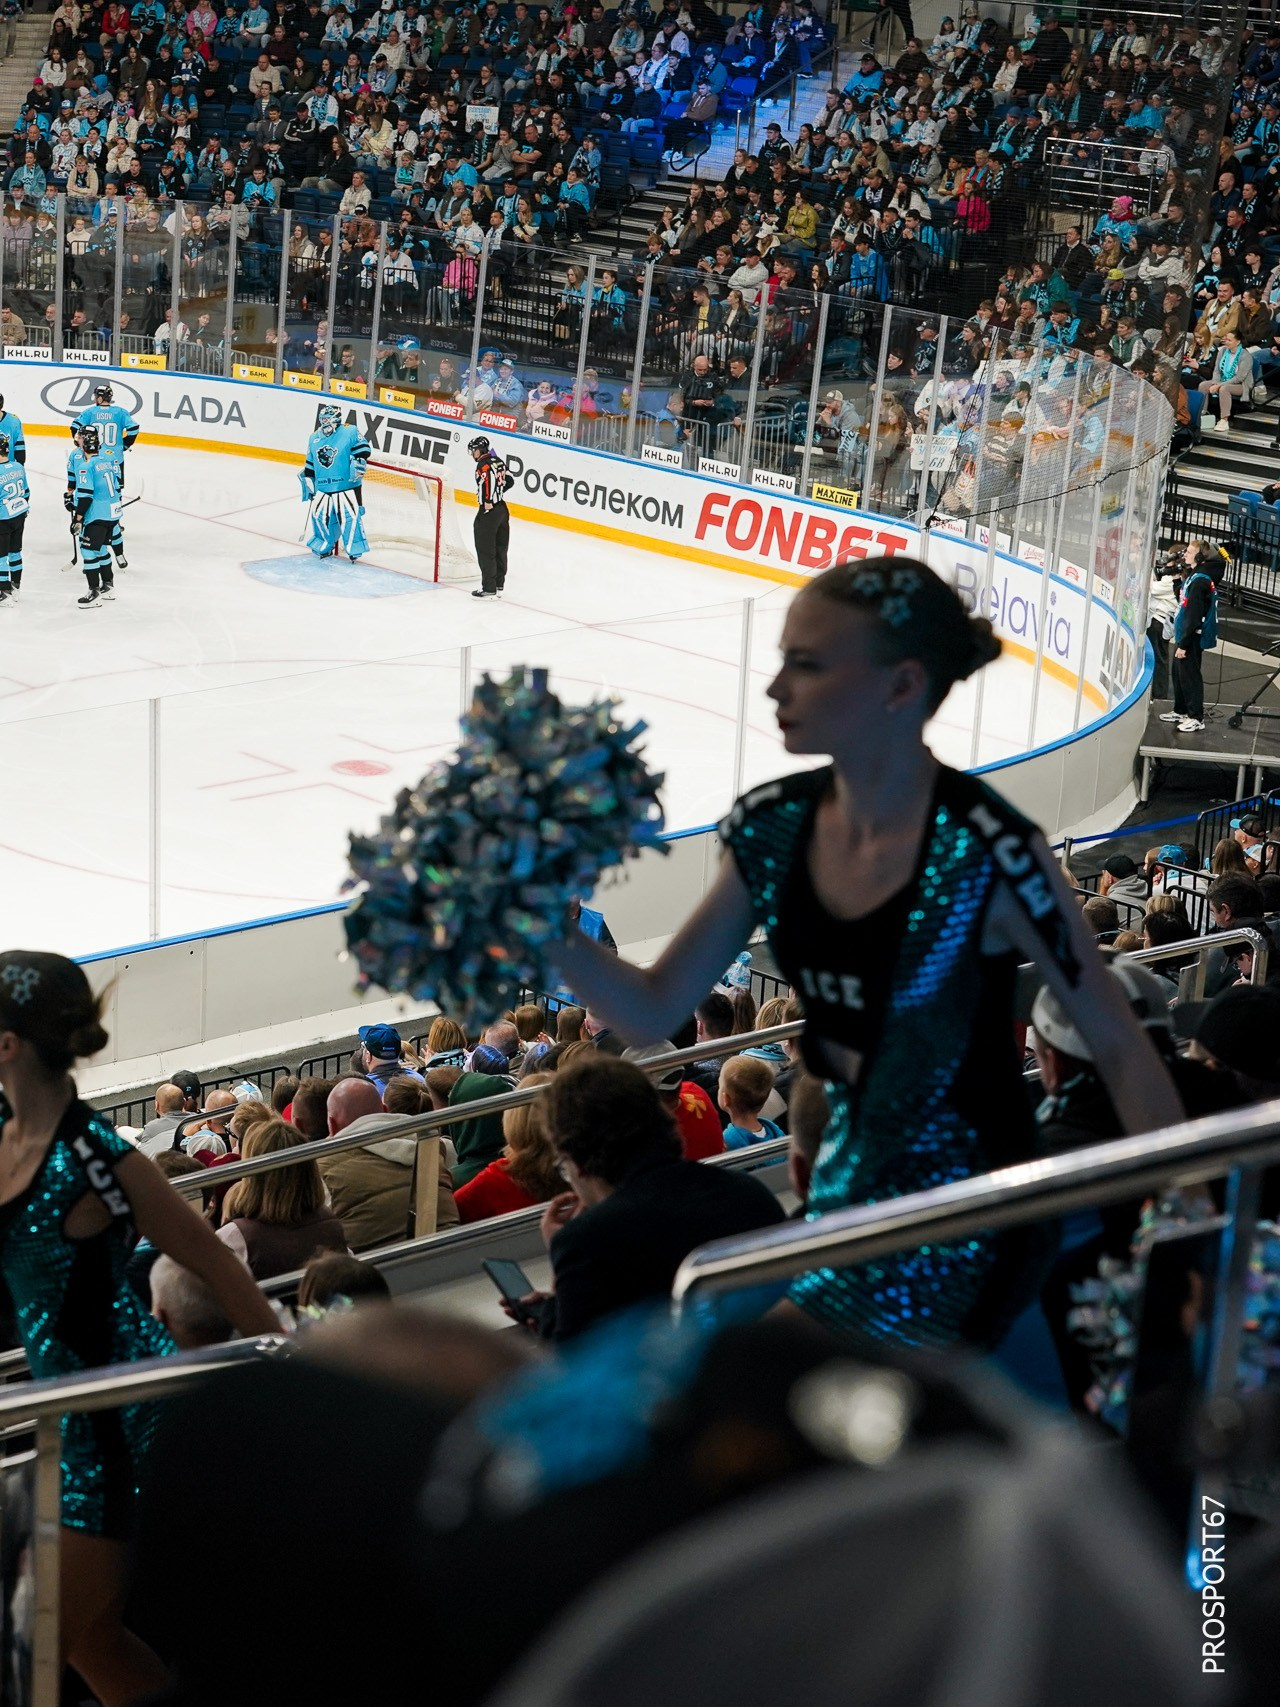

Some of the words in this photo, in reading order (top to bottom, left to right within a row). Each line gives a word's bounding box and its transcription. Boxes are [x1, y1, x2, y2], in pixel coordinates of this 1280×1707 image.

[7, 348, 50, 360] KHL.RU
[66, 352, 107, 364] KHL.RU
[298, 378, 316, 386] БАНК
[345, 386, 361, 394] БАНК
[393, 395, 409, 404] БАНК
[154, 392, 247, 428] LADA
[427, 402, 463, 418] FONBET
[480, 413, 516, 430] FONBET
[535, 425, 569, 440] KHL.RU
[644, 450, 680, 465] KHL.RU
[701, 462, 738, 478] KHL.RU
[754, 474, 793, 490] KHL.RU
[505, 454, 683, 529] Ростелеком
[956, 563, 1070, 659] Belavia
